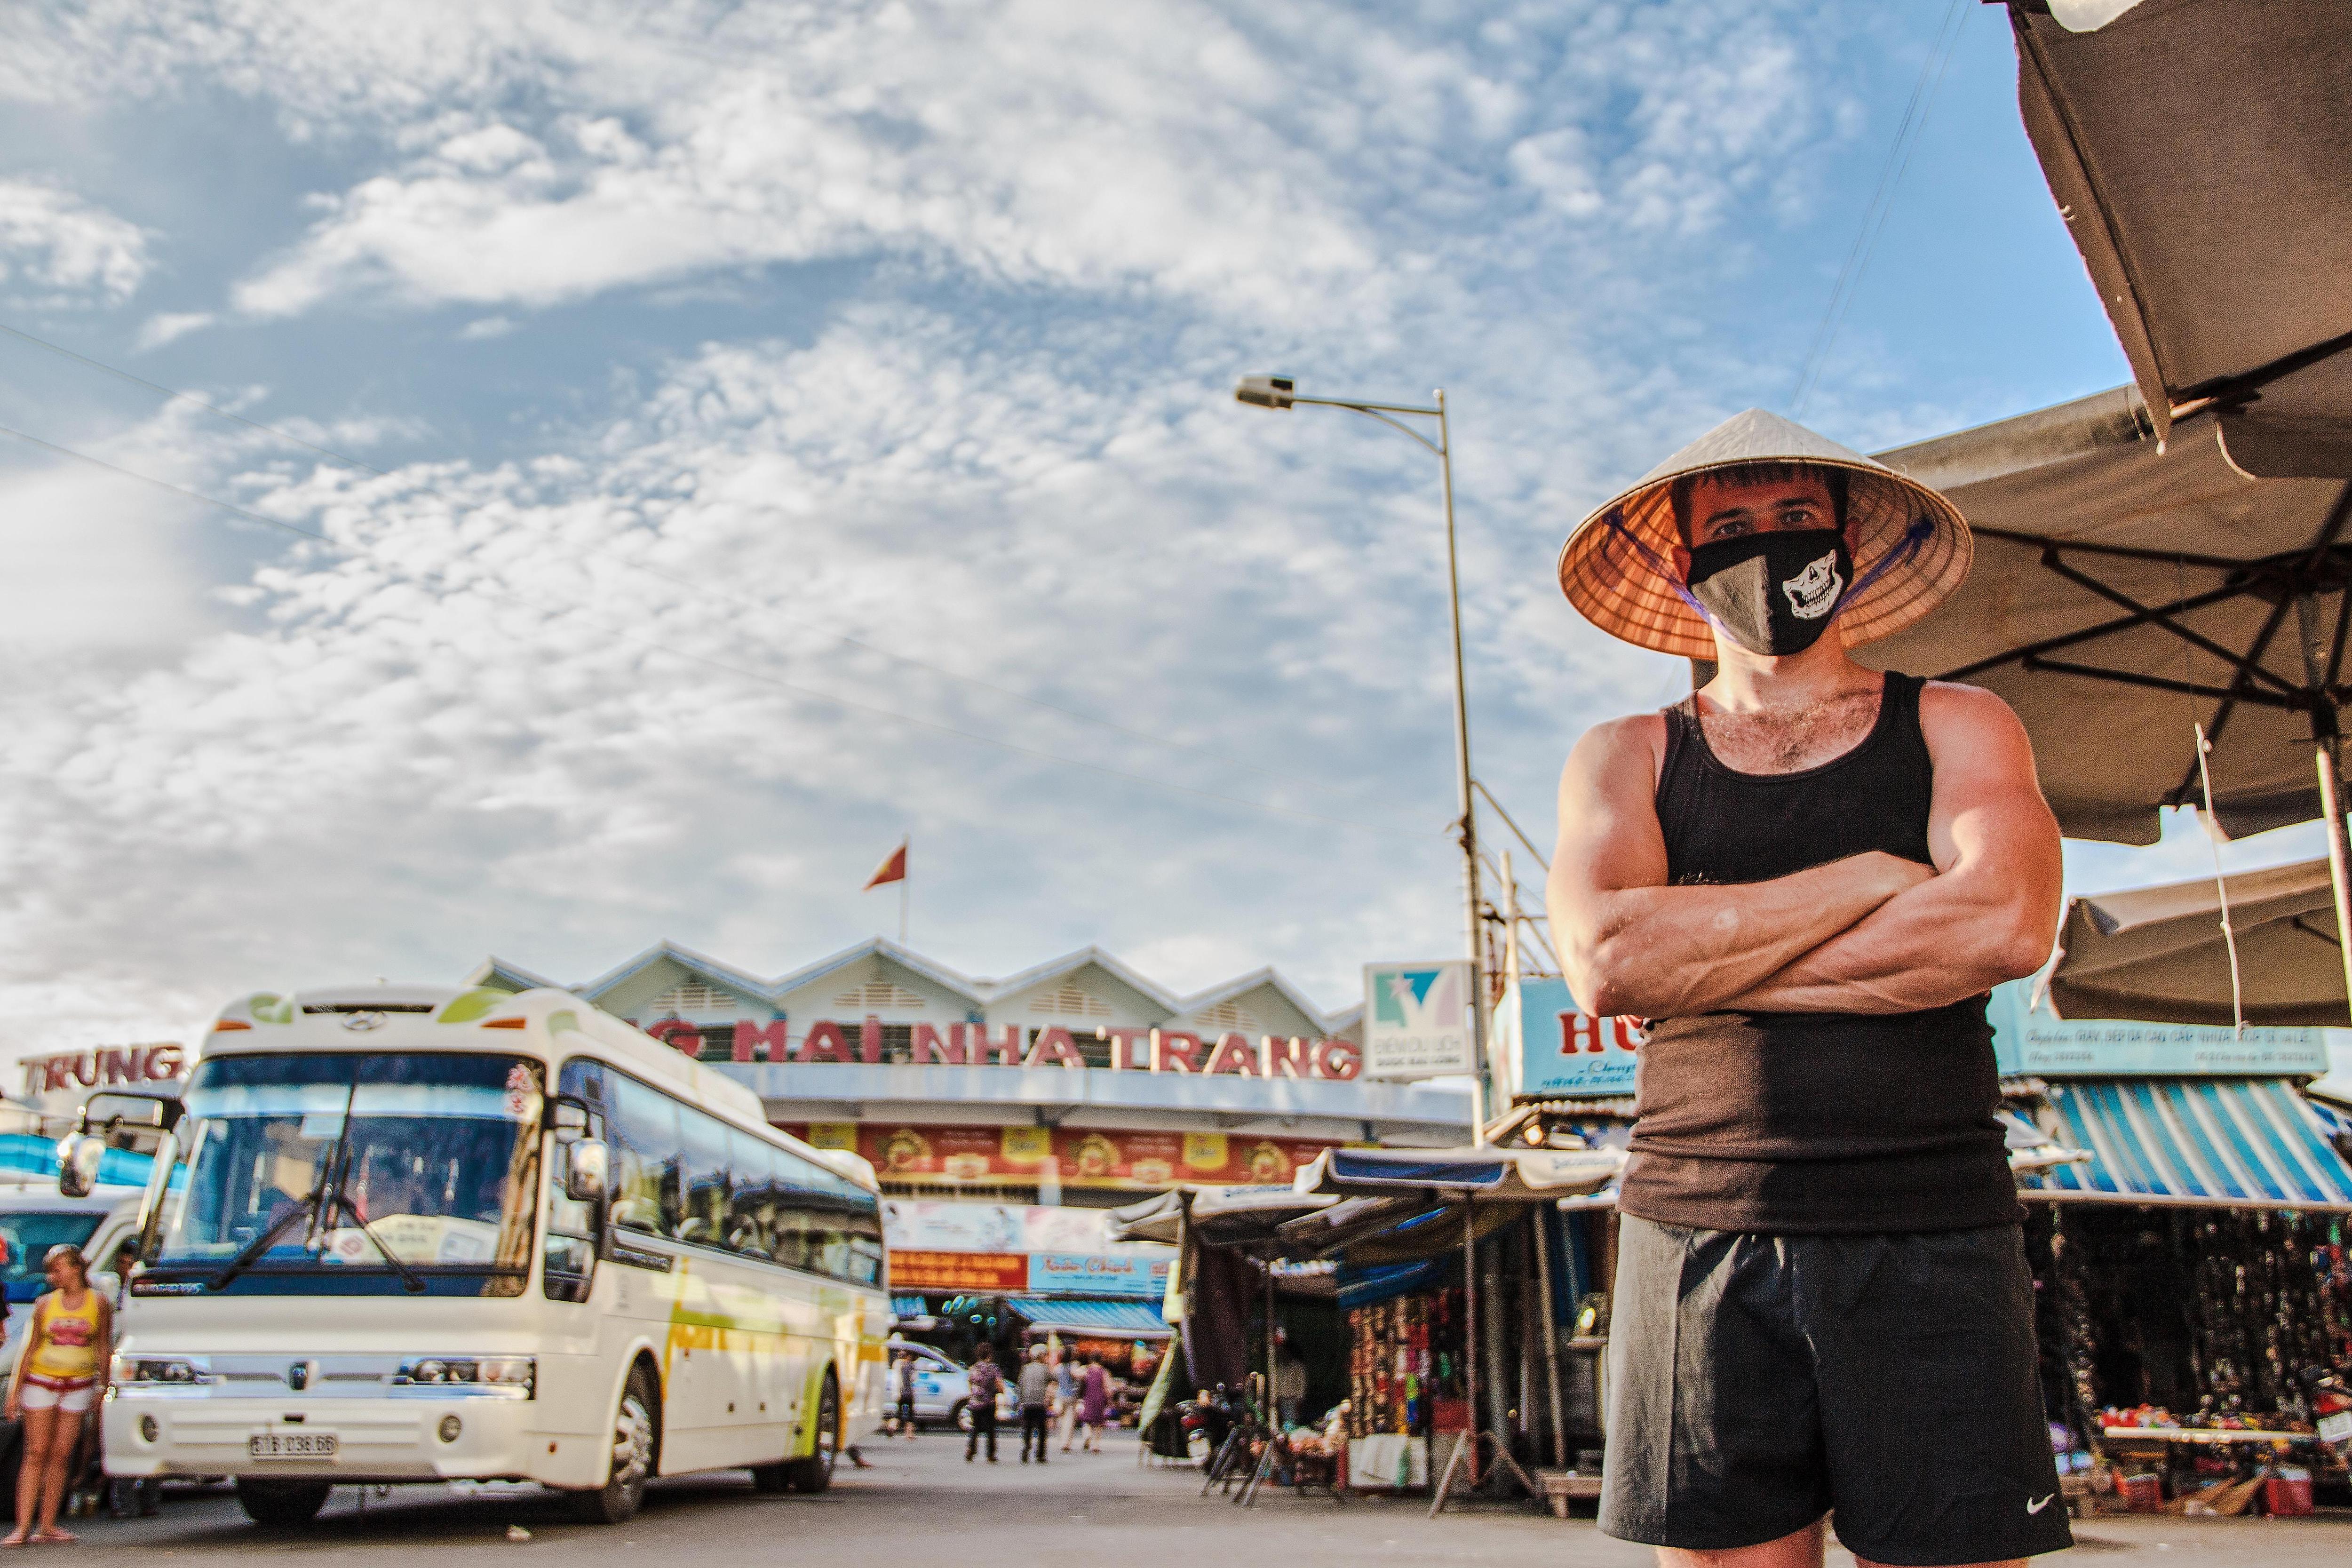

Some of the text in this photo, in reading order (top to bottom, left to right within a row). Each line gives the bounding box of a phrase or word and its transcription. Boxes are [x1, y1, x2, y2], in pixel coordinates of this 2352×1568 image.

[19, 1041, 186, 1097] TRUNG
[912, 1022, 1086, 1066] NHA
[1097, 1026, 1363, 1081] TRANG
